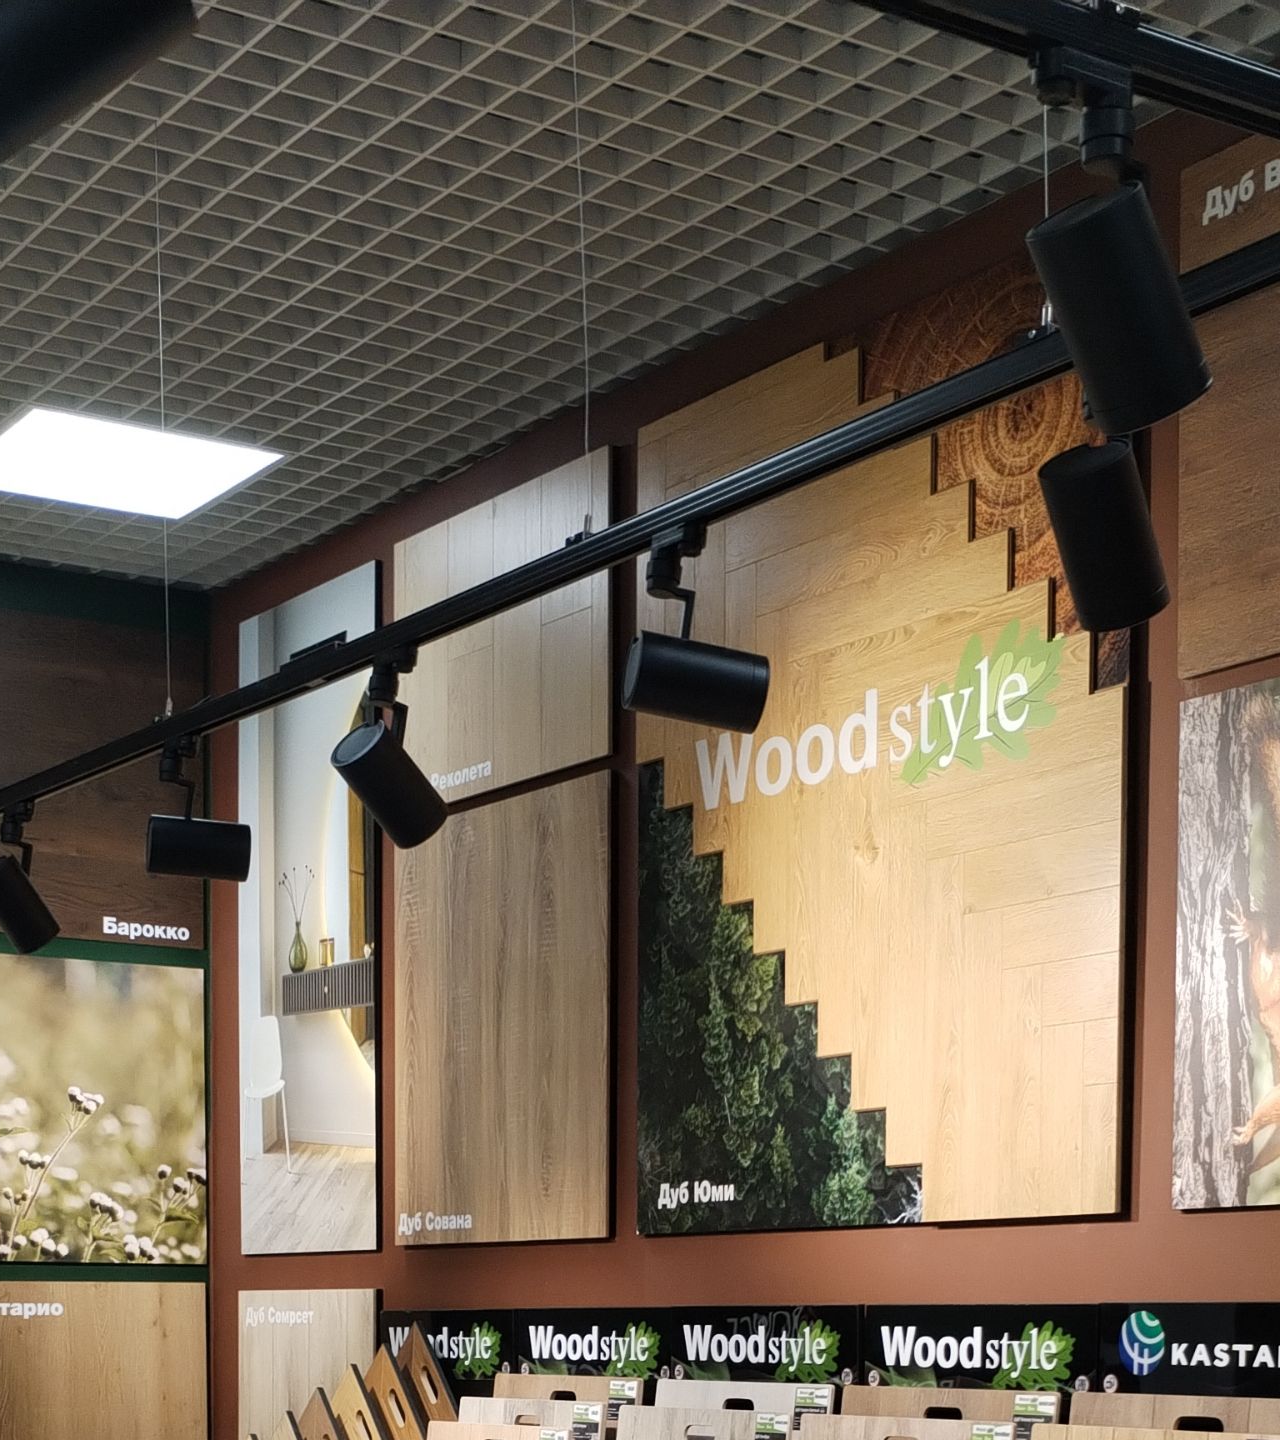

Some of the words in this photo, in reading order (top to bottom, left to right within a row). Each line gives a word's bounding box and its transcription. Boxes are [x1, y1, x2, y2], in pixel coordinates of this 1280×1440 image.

[1202, 170, 1254, 225] Дуб
[102, 916, 190, 941] Барокко
[658, 1182, 689, 1209] Дуб
[694, 1180, 735, 1203] Юми
[398, 1213, 421, 1236] Дуб
[425, 1211, 472, 1232] Сована
[246, 1306, 265, 1328] Дуб
